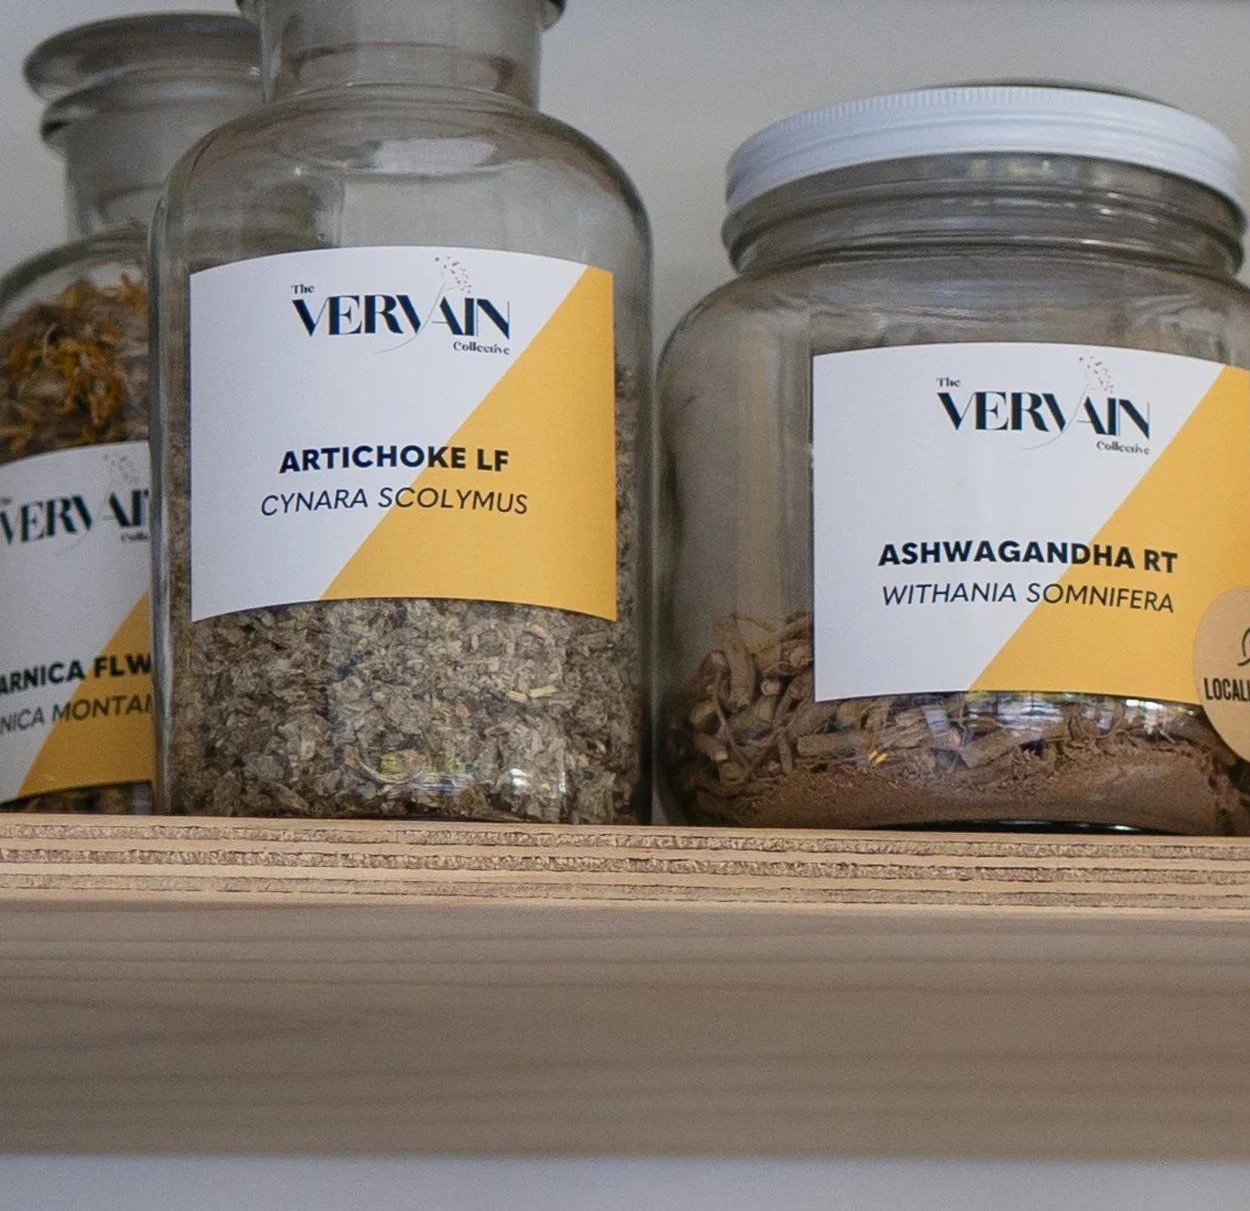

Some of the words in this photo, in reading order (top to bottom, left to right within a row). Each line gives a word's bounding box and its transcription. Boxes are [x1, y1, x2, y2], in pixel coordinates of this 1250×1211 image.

[291, 284, 315, 295] The
[292, 294, 510, 339] VERVAIN
[453, 341, 511, 355] Collective
[936, 377, 961, 388] The
[937, 391, 1150, 439] VERVAIN
[279, 445, 467, 474] ARTICHOKE
[476, 448, 509, 472] LF
[1096, 440, 1150, 455] Collective
[260, 487, 369, 517] CYNARA
[378, 486, 528, 515] SCOLYMUS
[0, 490, 149, 546] VERVAI
[877, 540, 1135, 569] ASHWAGANDHA
[1144, 548, 1178, 573] RT
[882, 582, 1018, 606] WITHANIA
[1025, 582, 1175, 614] SOMNIFERA
[0, 660, 86, 695] ARNICA
